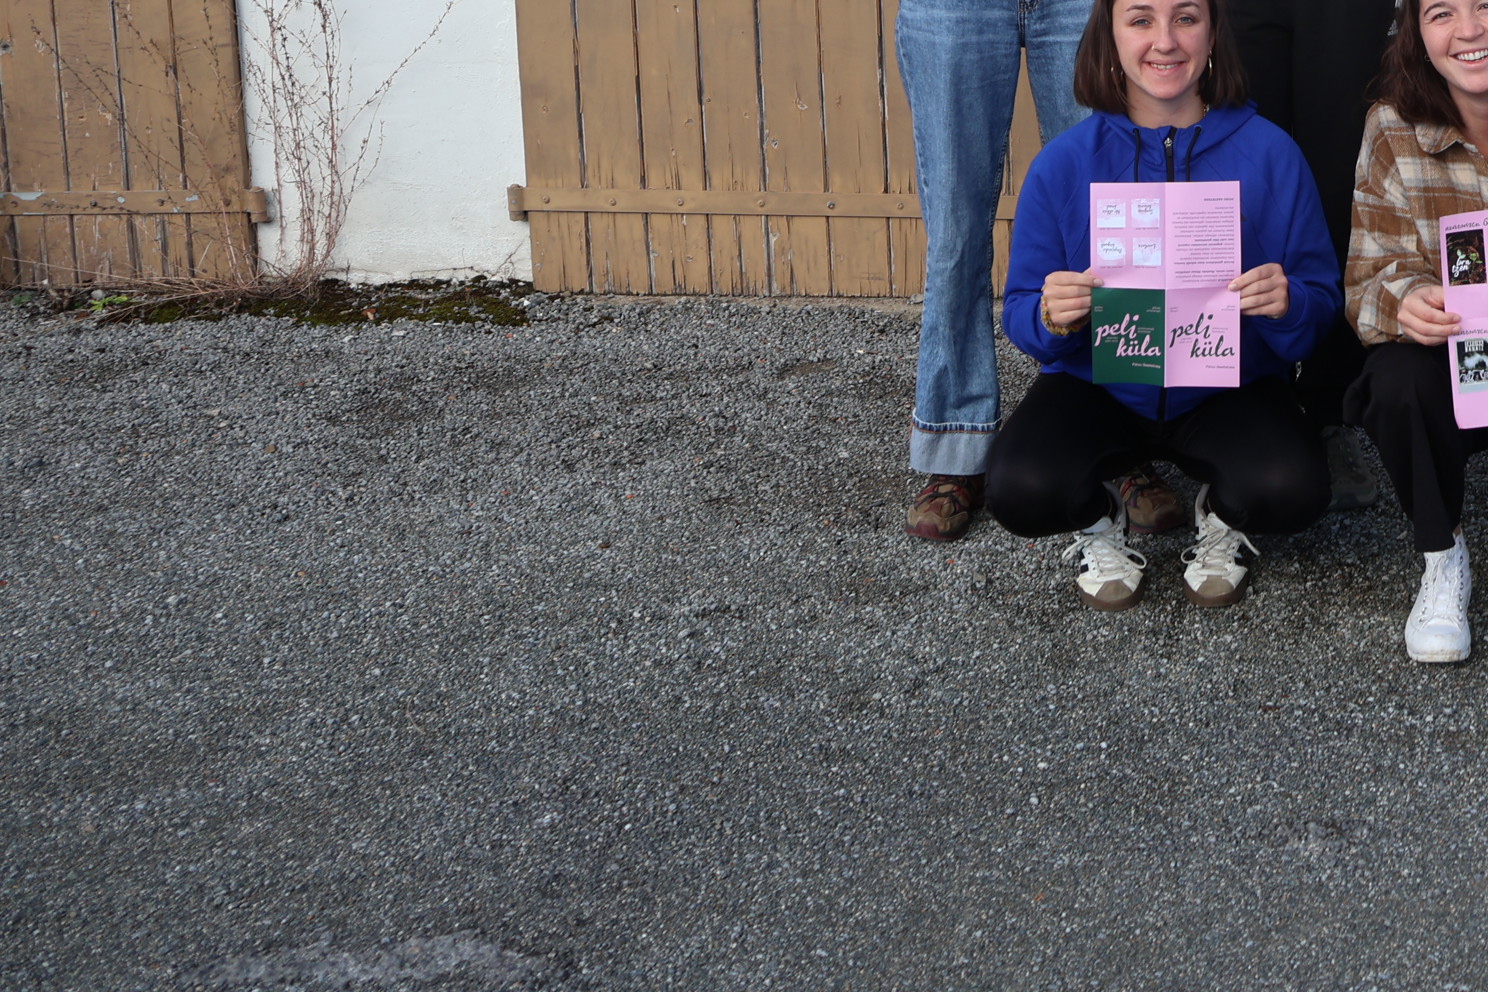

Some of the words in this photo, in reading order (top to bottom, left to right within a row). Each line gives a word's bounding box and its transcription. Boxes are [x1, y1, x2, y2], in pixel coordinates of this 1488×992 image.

[1094, 312, 1140, 347] peli
[1169, 312, 1214, 348] peli
[1116, 334, 1161, 357] küla
[1189, 335, 1235, 358] küla
